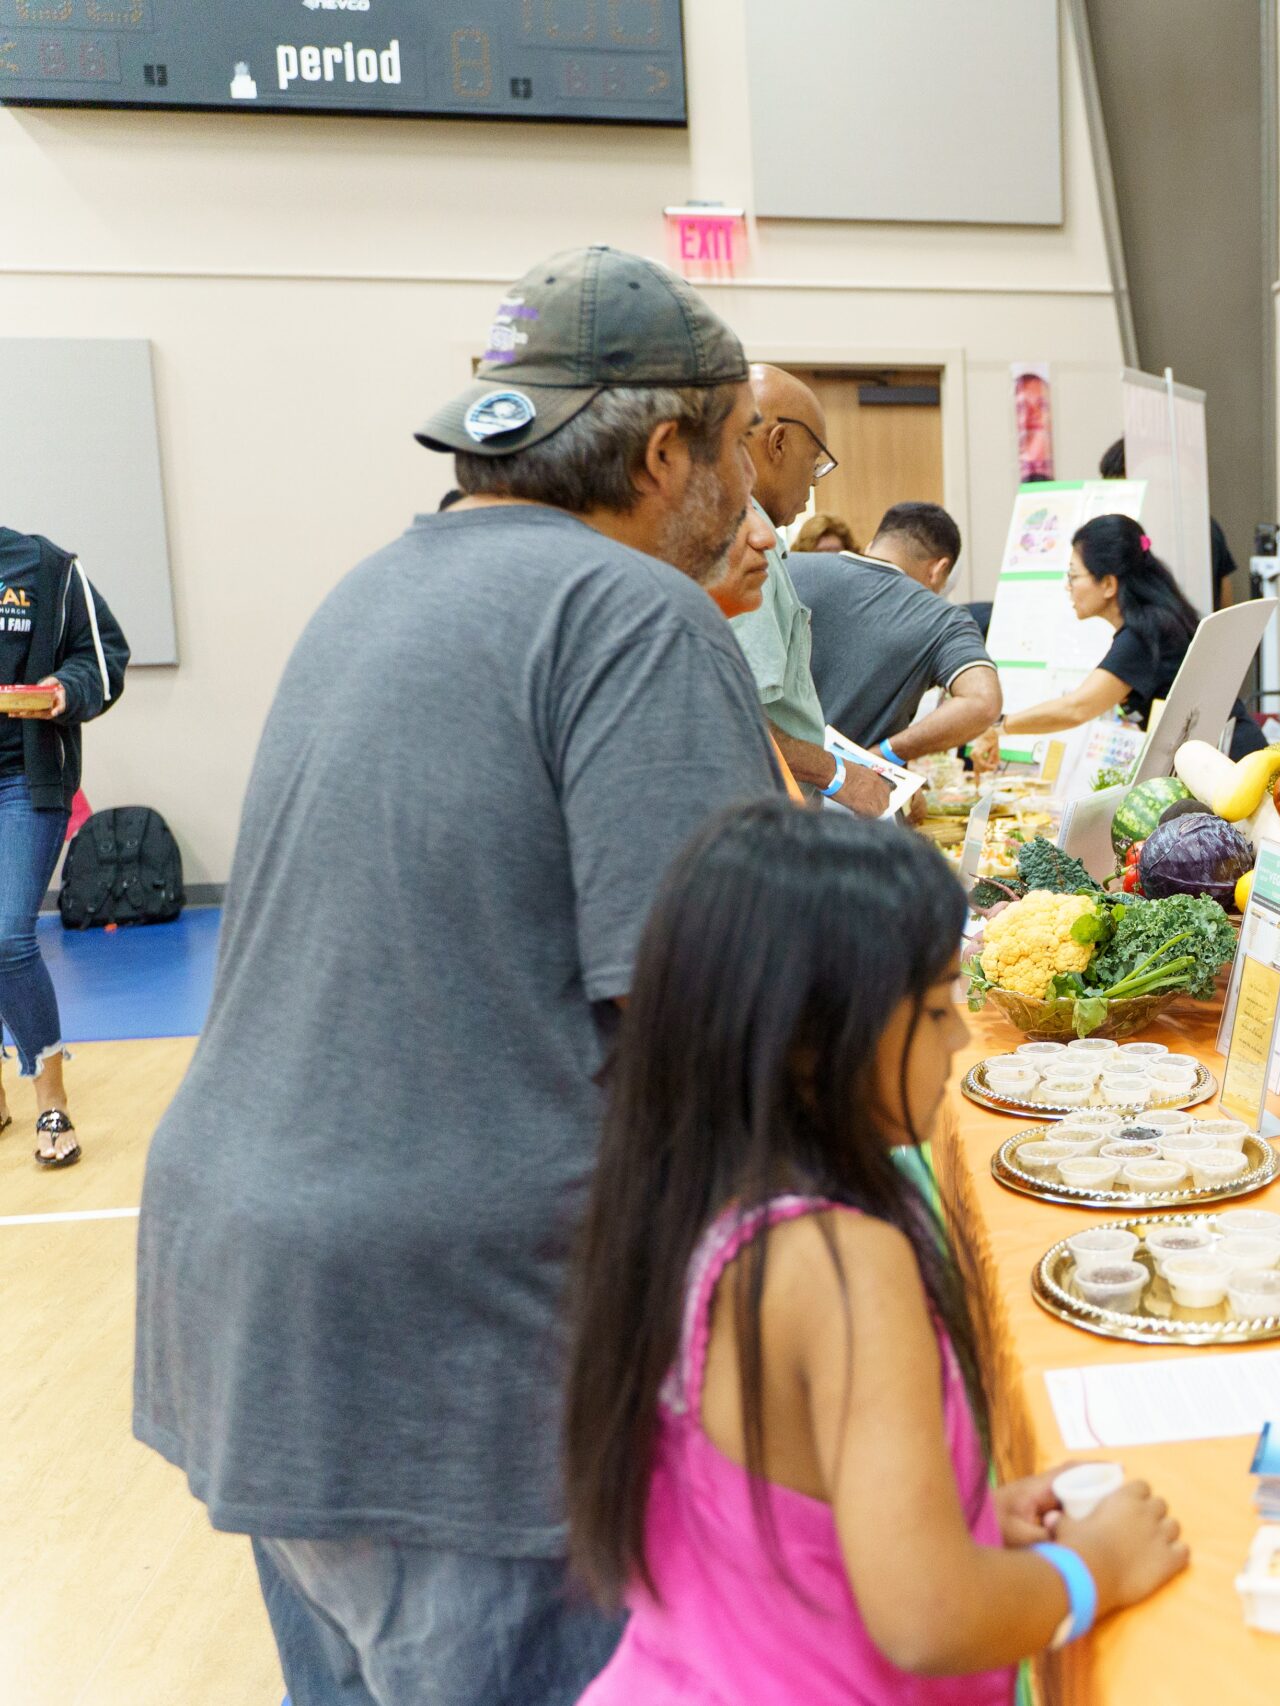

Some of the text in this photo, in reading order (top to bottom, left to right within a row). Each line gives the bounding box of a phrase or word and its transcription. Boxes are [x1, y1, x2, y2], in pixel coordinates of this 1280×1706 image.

[276, 39, 401, 90] period
[680, 220, 733, 260] EXIT
[8, 617, 32, 632] FAIR
